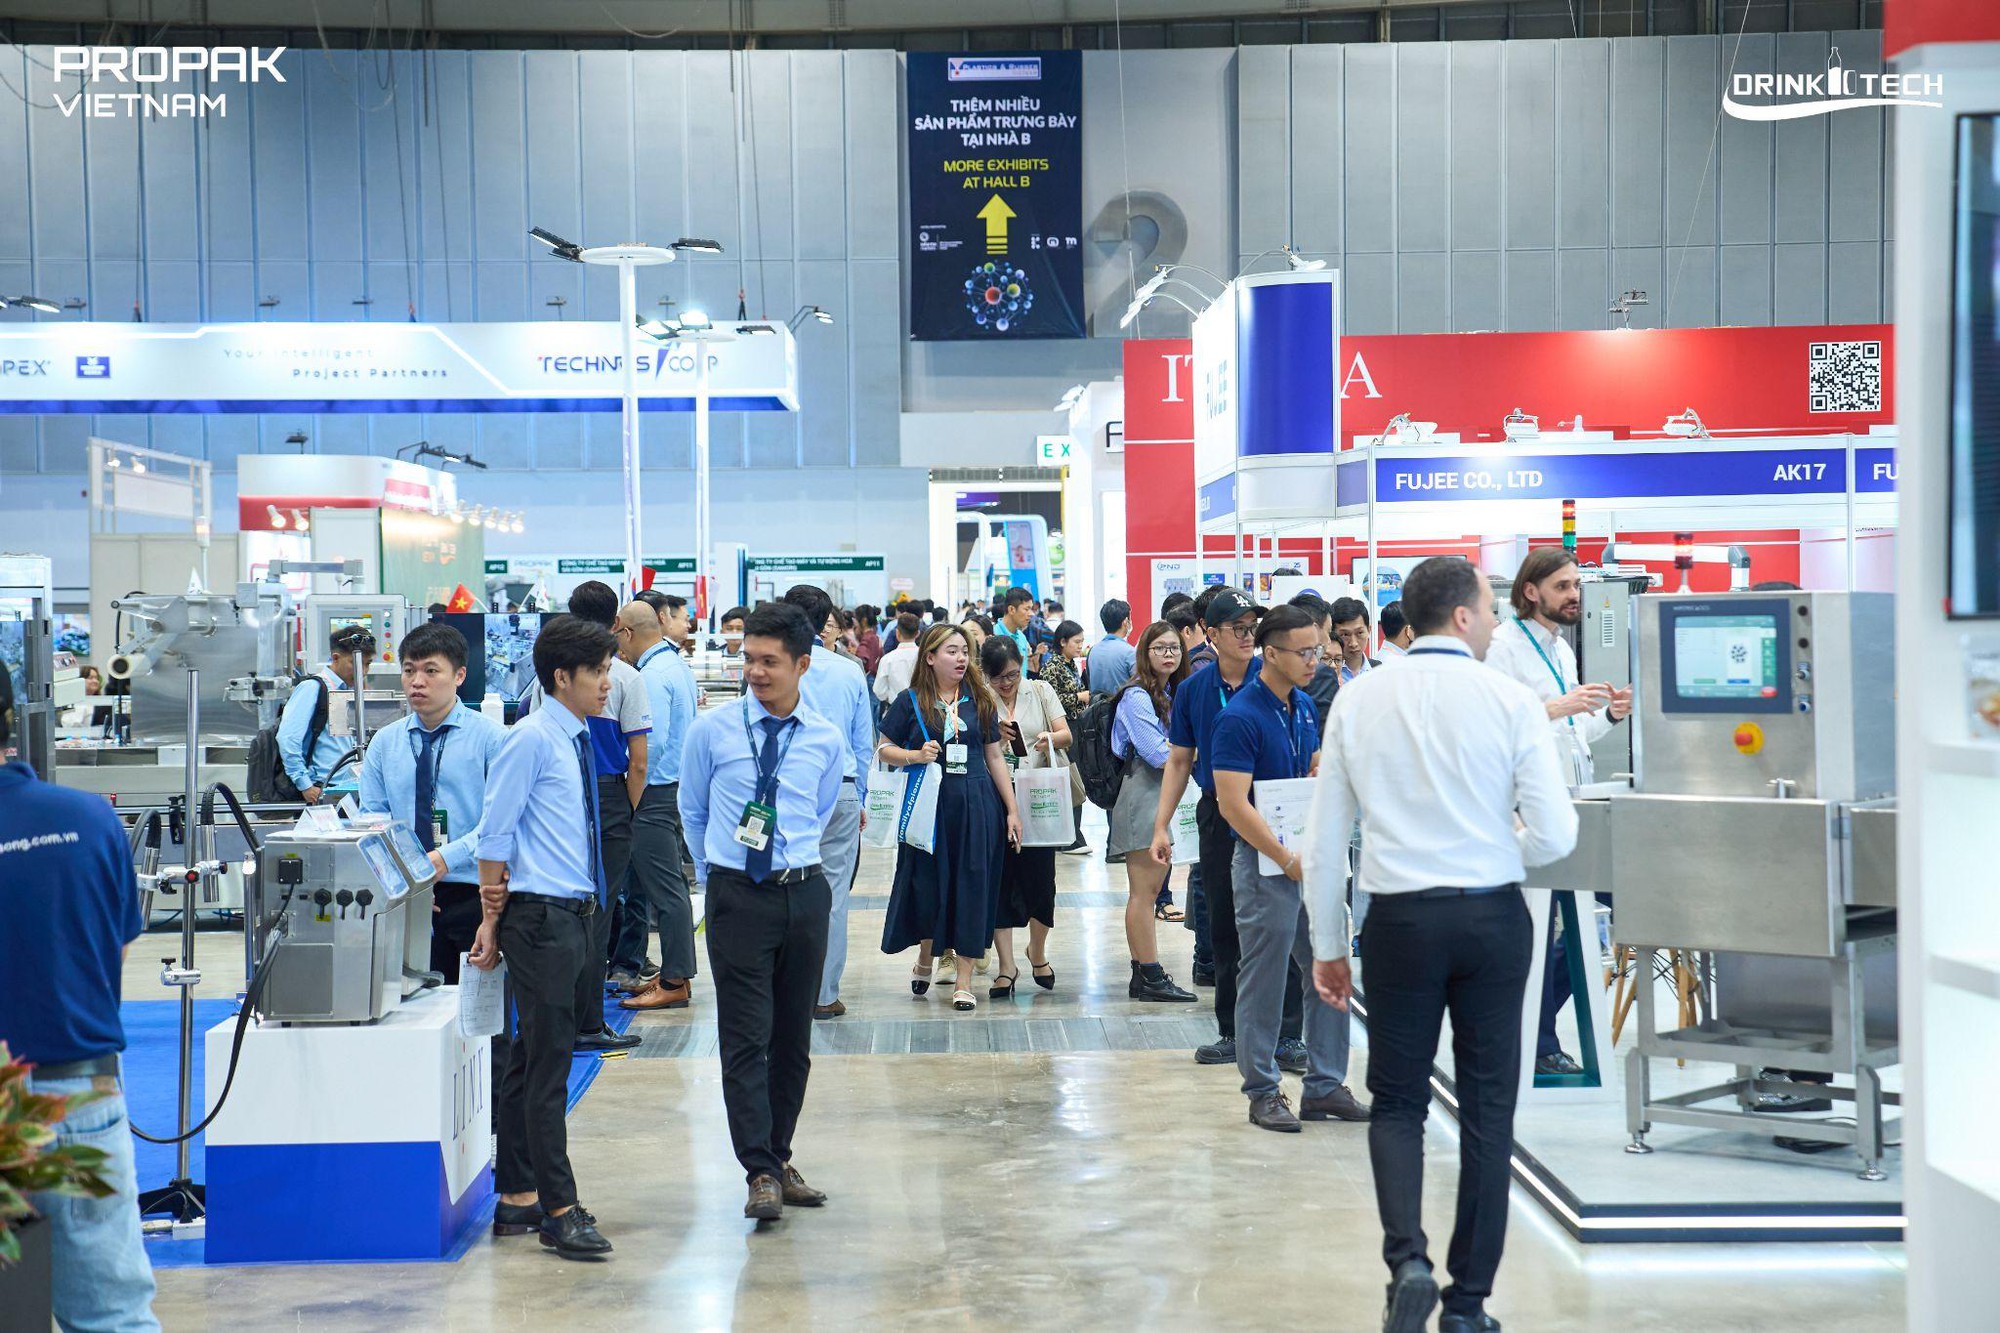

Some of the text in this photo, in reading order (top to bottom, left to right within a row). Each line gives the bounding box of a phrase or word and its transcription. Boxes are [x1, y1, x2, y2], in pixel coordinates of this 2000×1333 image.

[951, 95, 1040, 112] THÊM NHIỀU
[915, 115, 944, 130] SẢN
[993, 115, 1046, 128] TRƯNG
[1048, 112, 1077, 128] BÀY
[961, 130, 1031, 149] TẠI NHÀ B
[944, 159, 1049, 173] MORE EXHIBITS
[963, 176, 1031, 189] AT HALL B
[1092, 190, 1189, 338] 2
[669, 356, 718, 372] COP
[293, 368, 448, 380] Project Partners
[1396, 470, 1543, 491] FUJEE CO., LTD
[1773, 463, 1827, 481] AK17
[1232, 593, 1250, 608] LA
[453, 1046, 484, 1141] LINX
